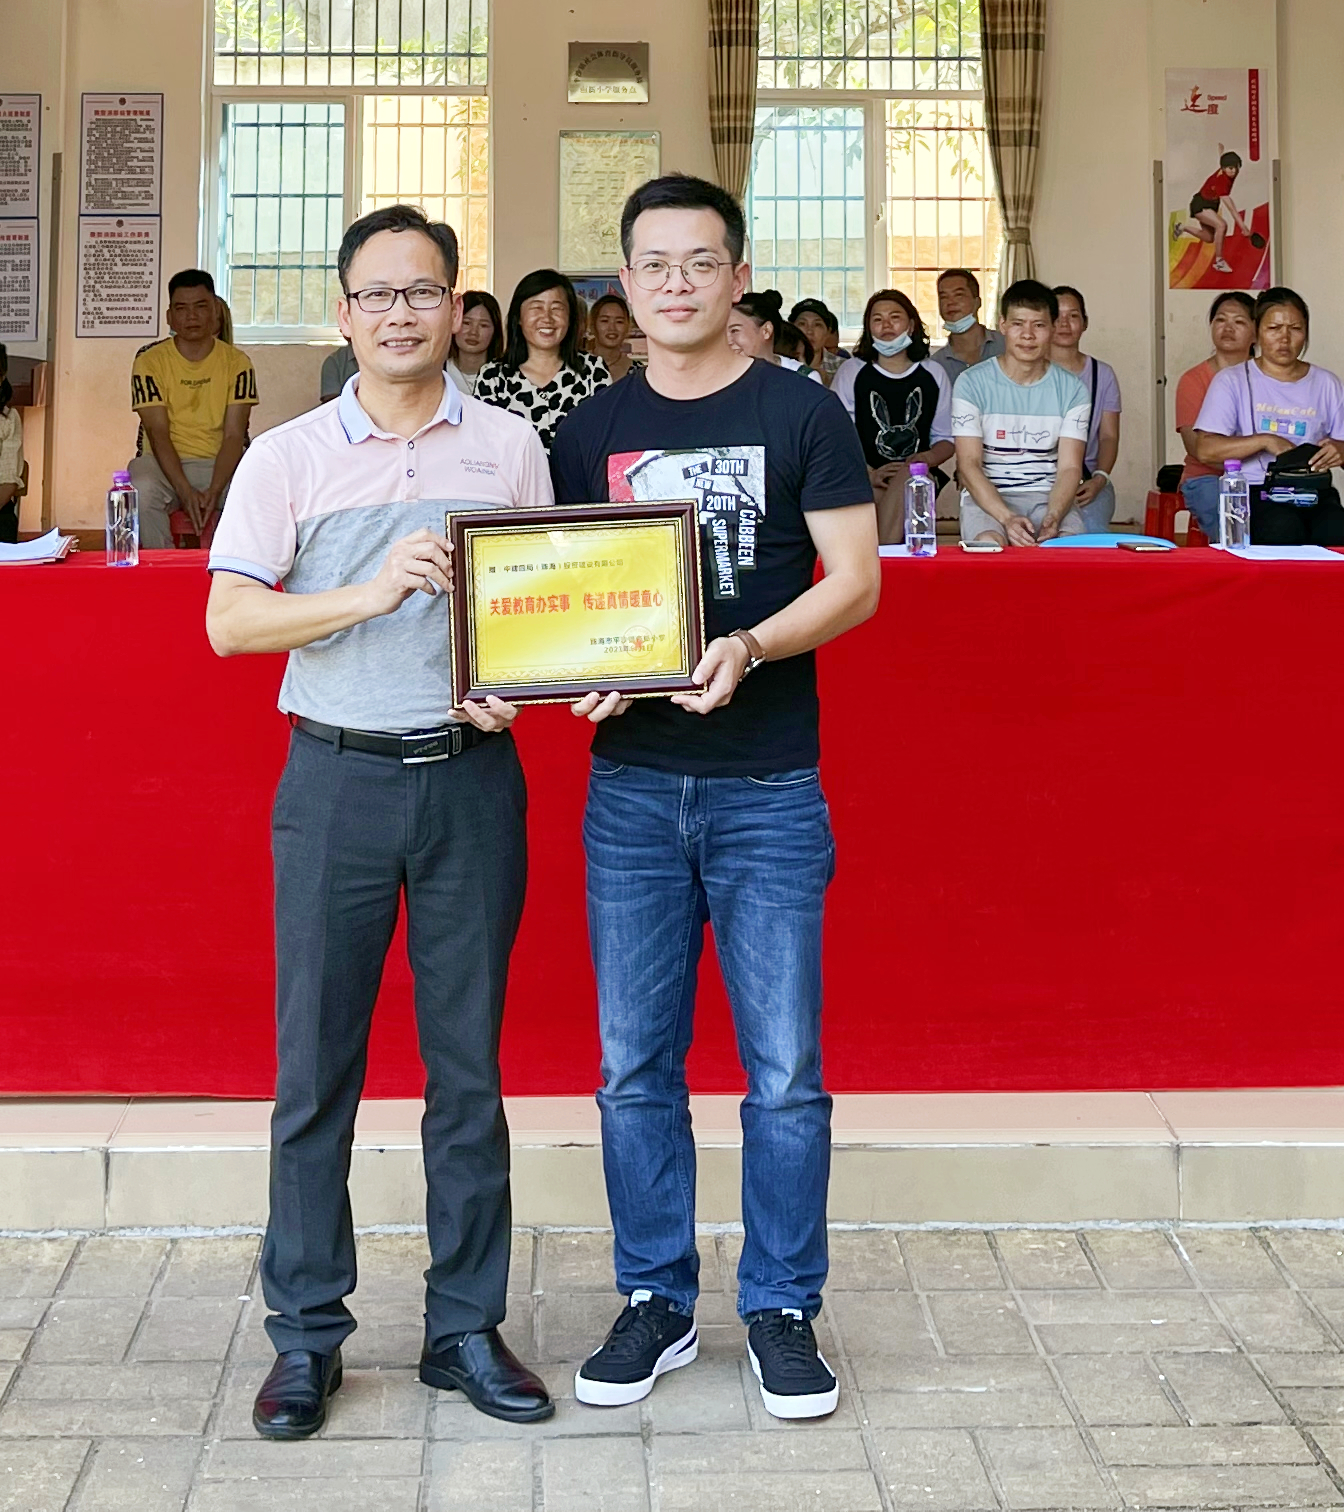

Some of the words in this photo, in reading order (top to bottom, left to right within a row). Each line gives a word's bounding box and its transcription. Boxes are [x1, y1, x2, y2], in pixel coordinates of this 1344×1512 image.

[715, 460, 744, 474] 30TH
[706, 495, 736, 511] 20TH
[738, 509, 756, 566] CABBEEN
[712, 518, 735, 596] SUPERMARKET
[490, 593, 570, 616] 关爱教育办实事
[583, 589, 663, 611] 传递真情暖童心
